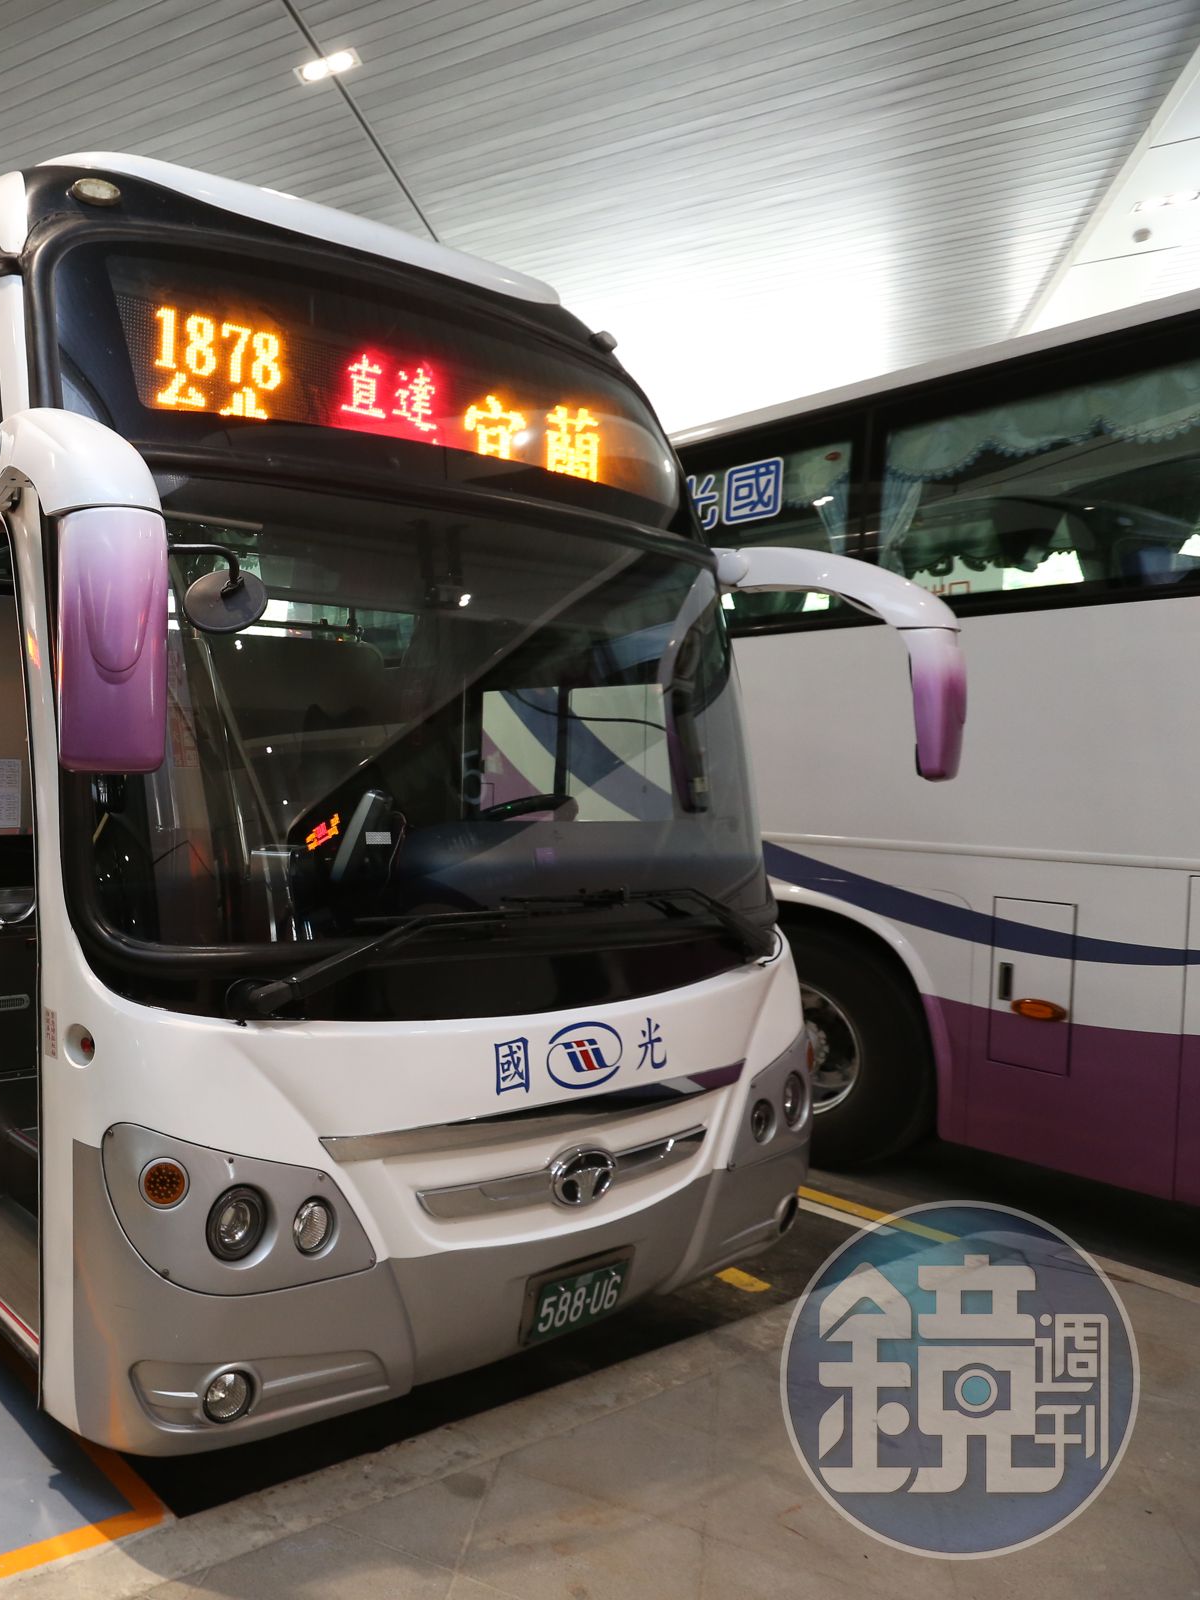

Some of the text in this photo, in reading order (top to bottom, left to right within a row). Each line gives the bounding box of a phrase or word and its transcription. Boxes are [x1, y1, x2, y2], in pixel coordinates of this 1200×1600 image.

[155, 307, 282, 390] 1878
[341, 354, 438, 434] 直達
[464, 395, 599, 482] 宜蘭
[538, 1274, 621, 1332] 588-U6
